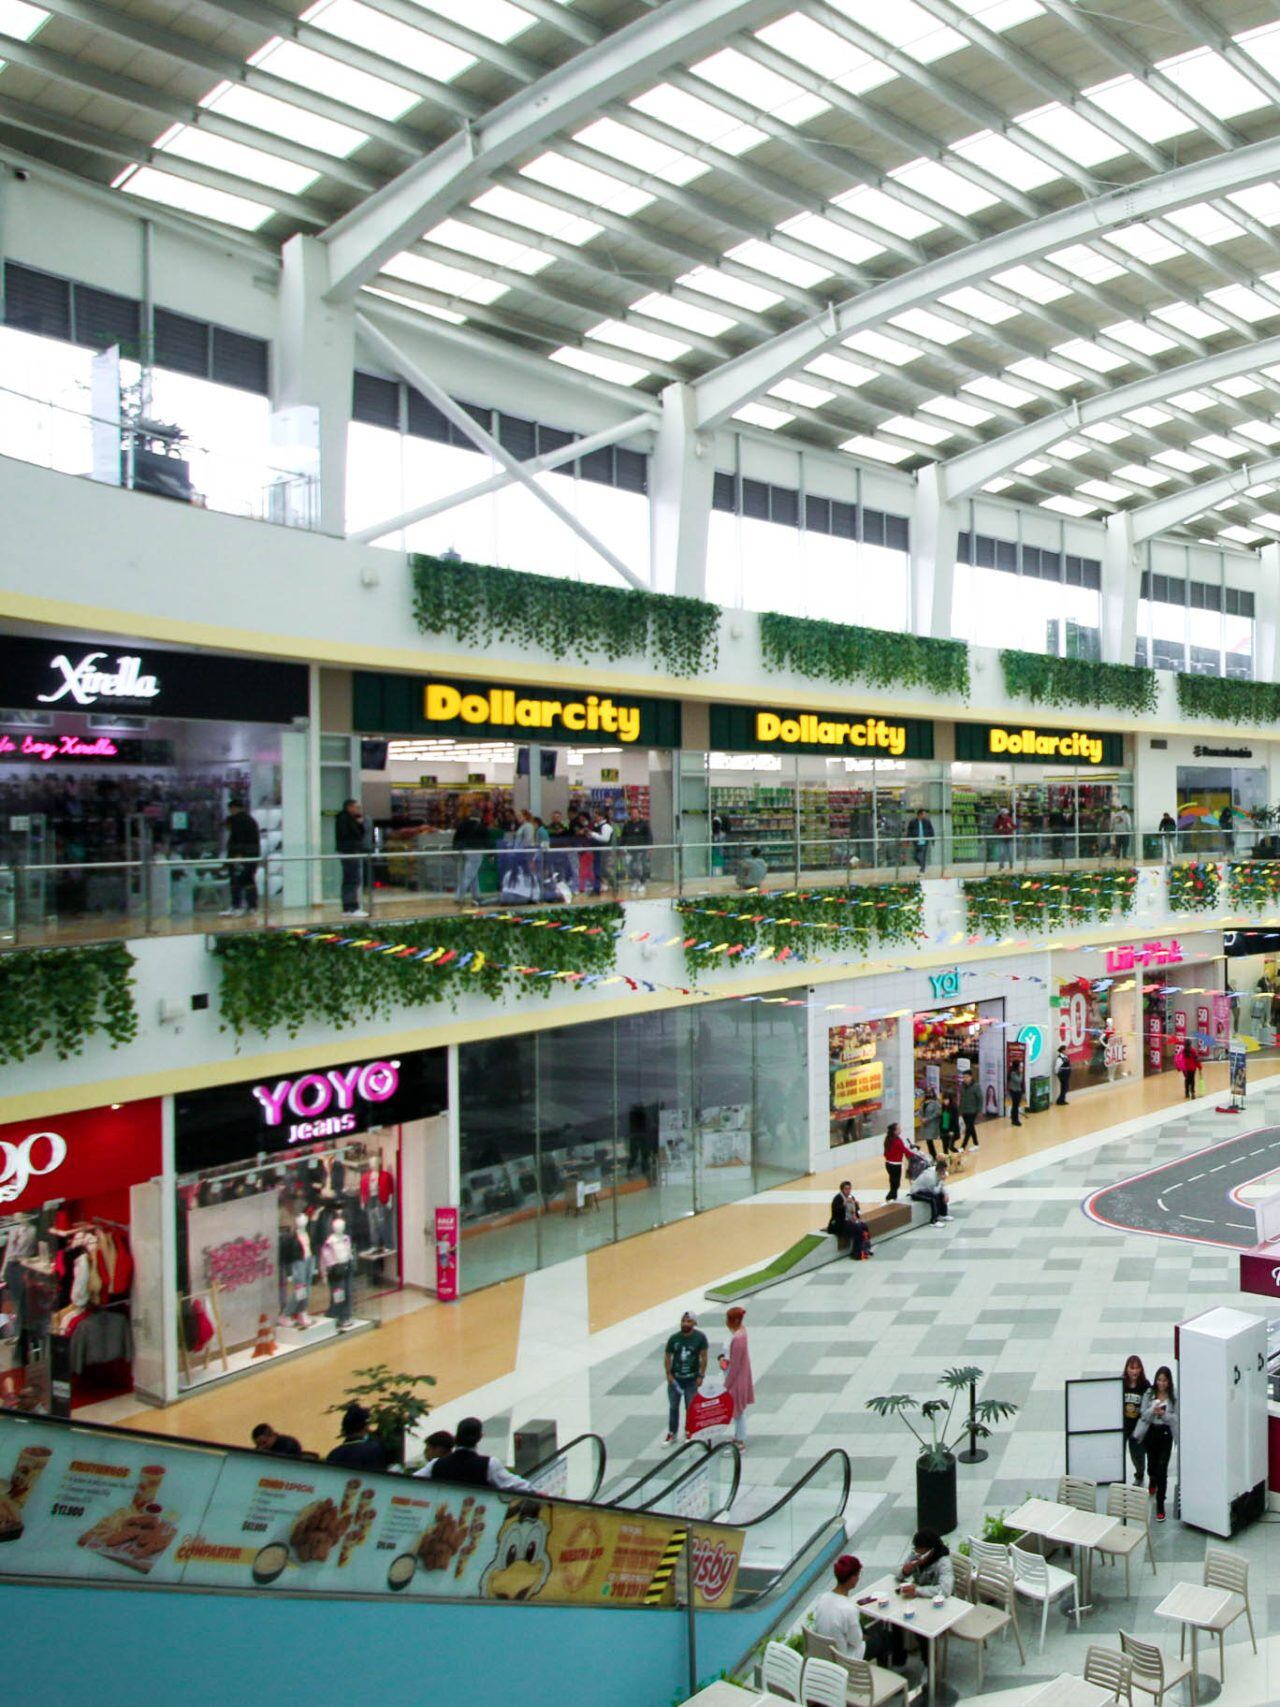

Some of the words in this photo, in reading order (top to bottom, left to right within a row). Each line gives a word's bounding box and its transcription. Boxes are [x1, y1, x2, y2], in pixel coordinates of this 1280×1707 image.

[425, 684, 640, 742] Dollarcity
[757, 712, 905, 755] Dollarcity
[990, 729, 1102, 763] Dollarcity
[1104, 1045, 1127, 1067] SALE
[252, 1061, 399, 1126] YOYO
